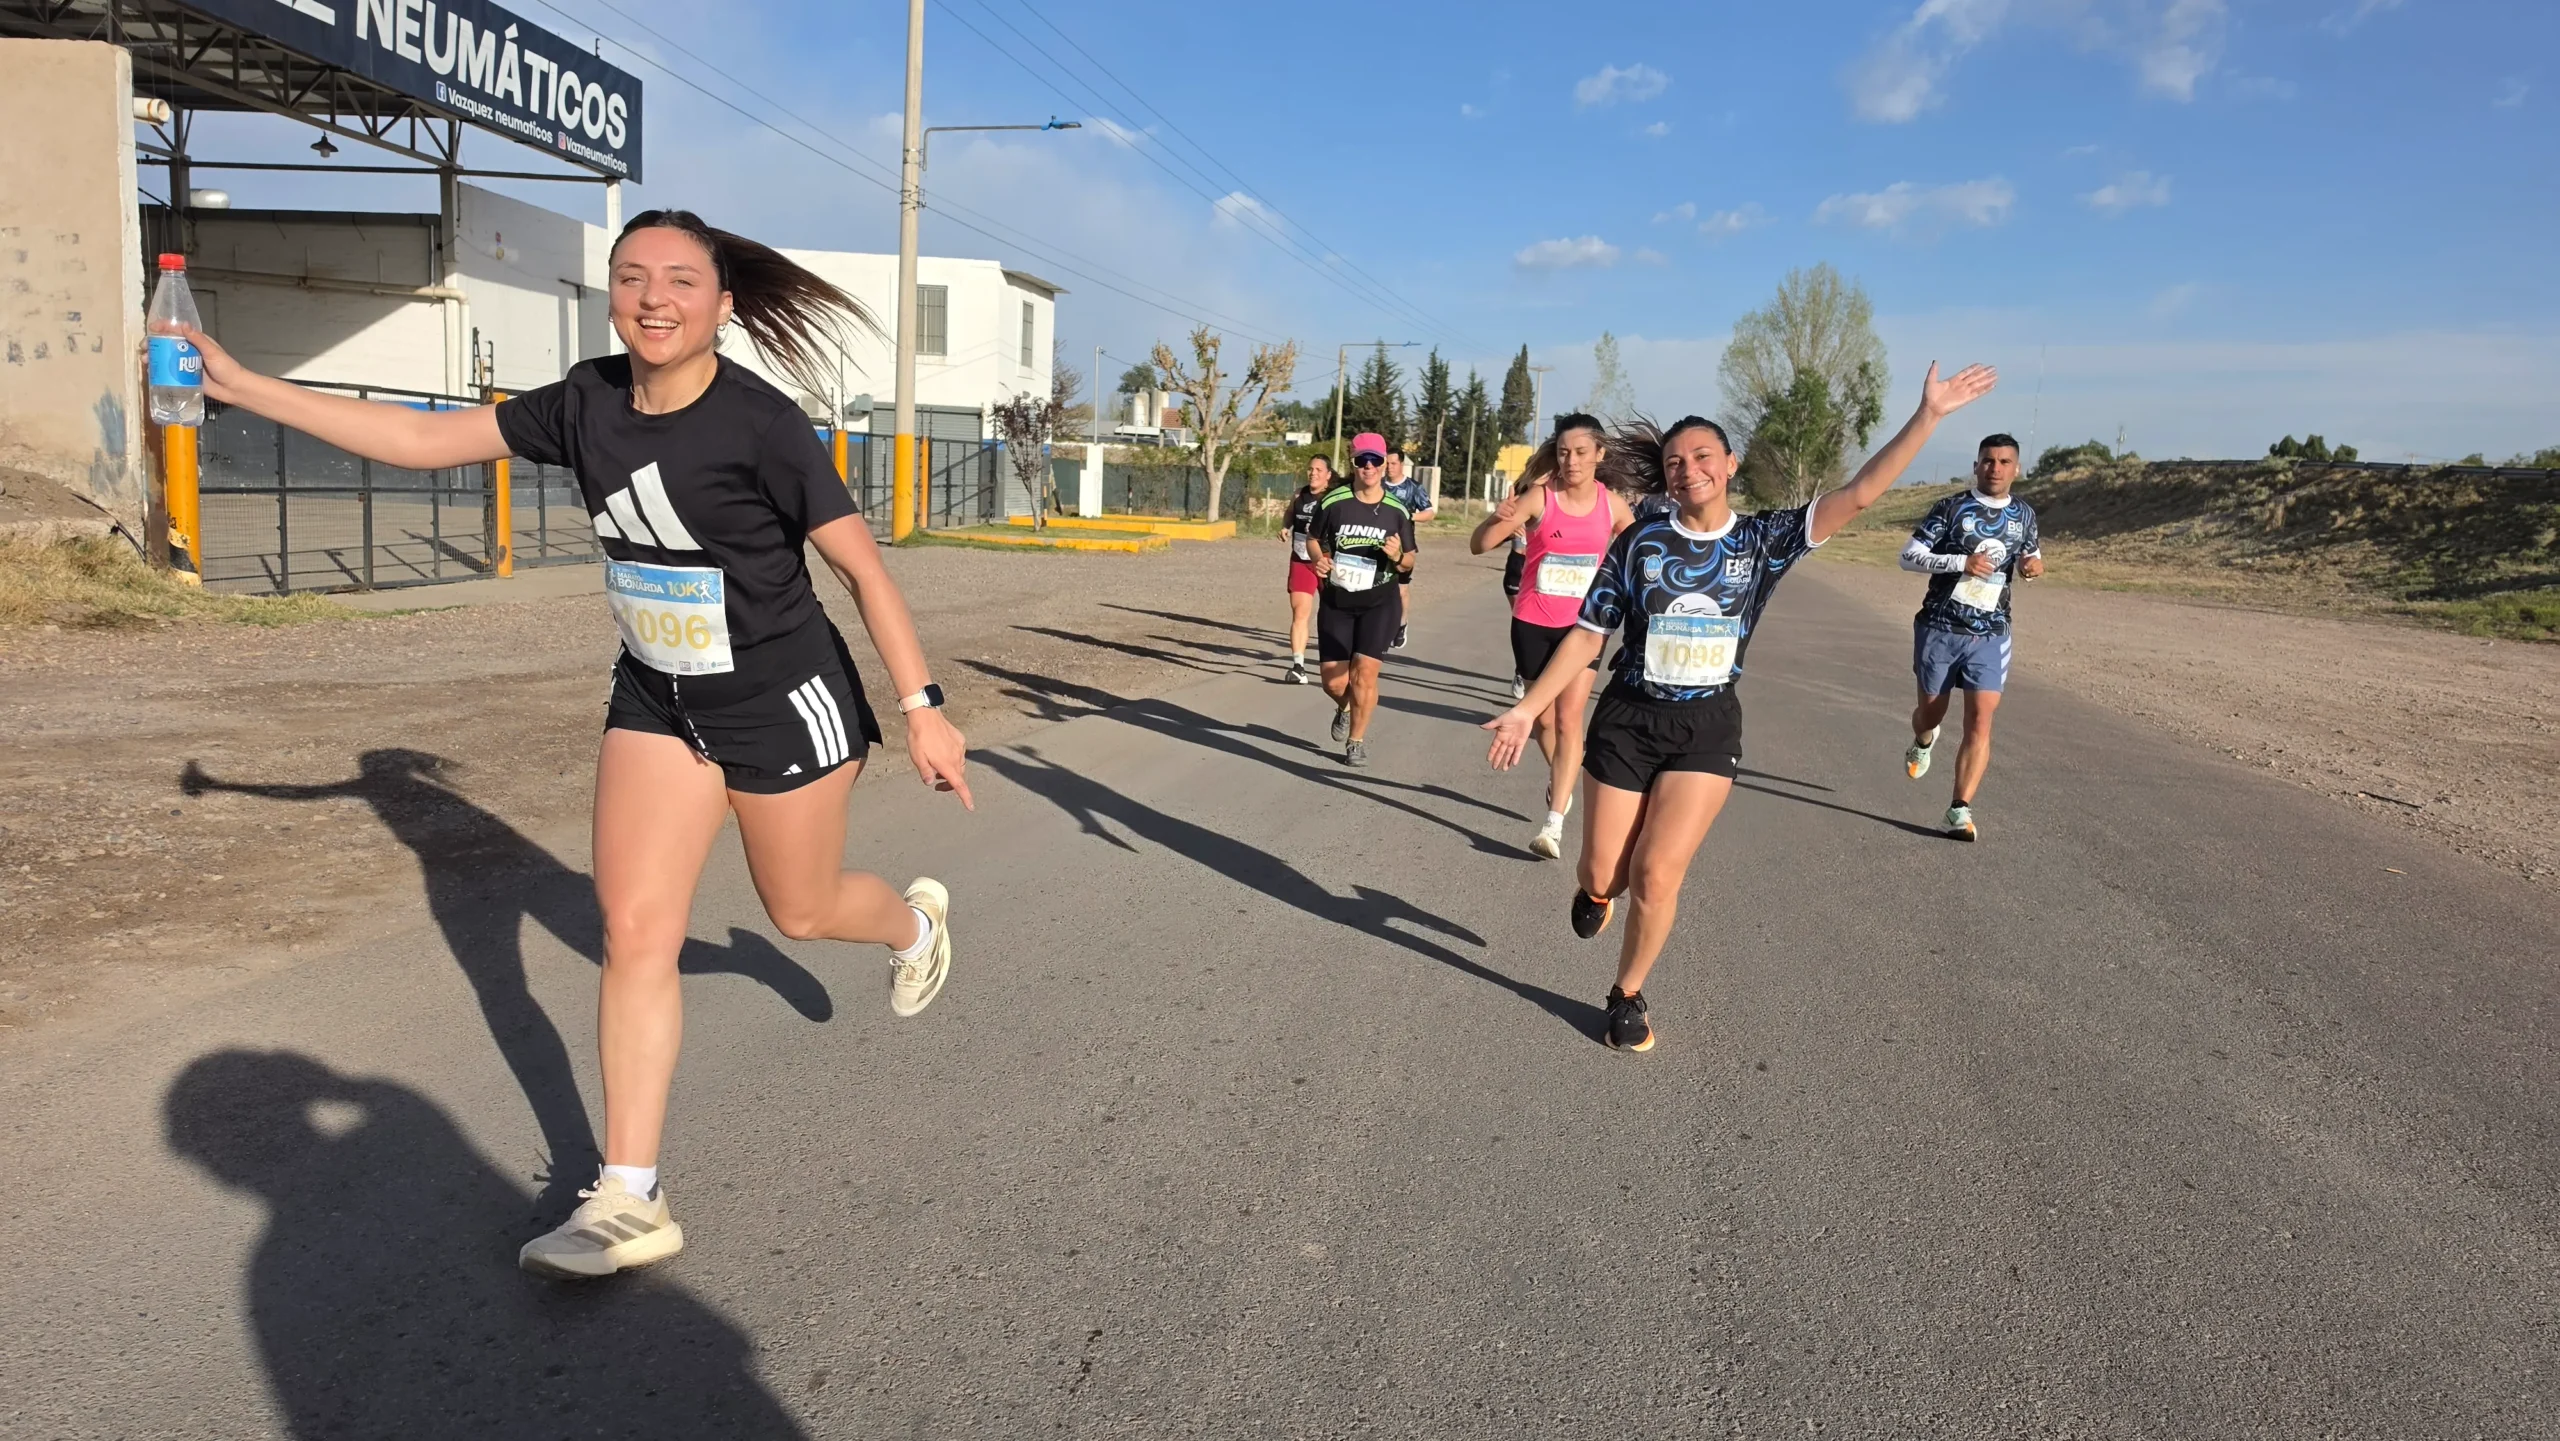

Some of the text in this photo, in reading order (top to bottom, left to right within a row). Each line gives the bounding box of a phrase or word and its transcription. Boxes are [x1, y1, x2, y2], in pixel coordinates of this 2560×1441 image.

[356, 0, 628, 149] NEUMÁTICOS
[448, 87, 554, 145] Vazquez neumaticos
[566, 136, 628, 175] Vazneumaticos
[1335, 524, 1387, 540] JUNIN
[617, 577, 700, 598] BONARDA 10K
[1657, 640, 1725, 668] 1098
